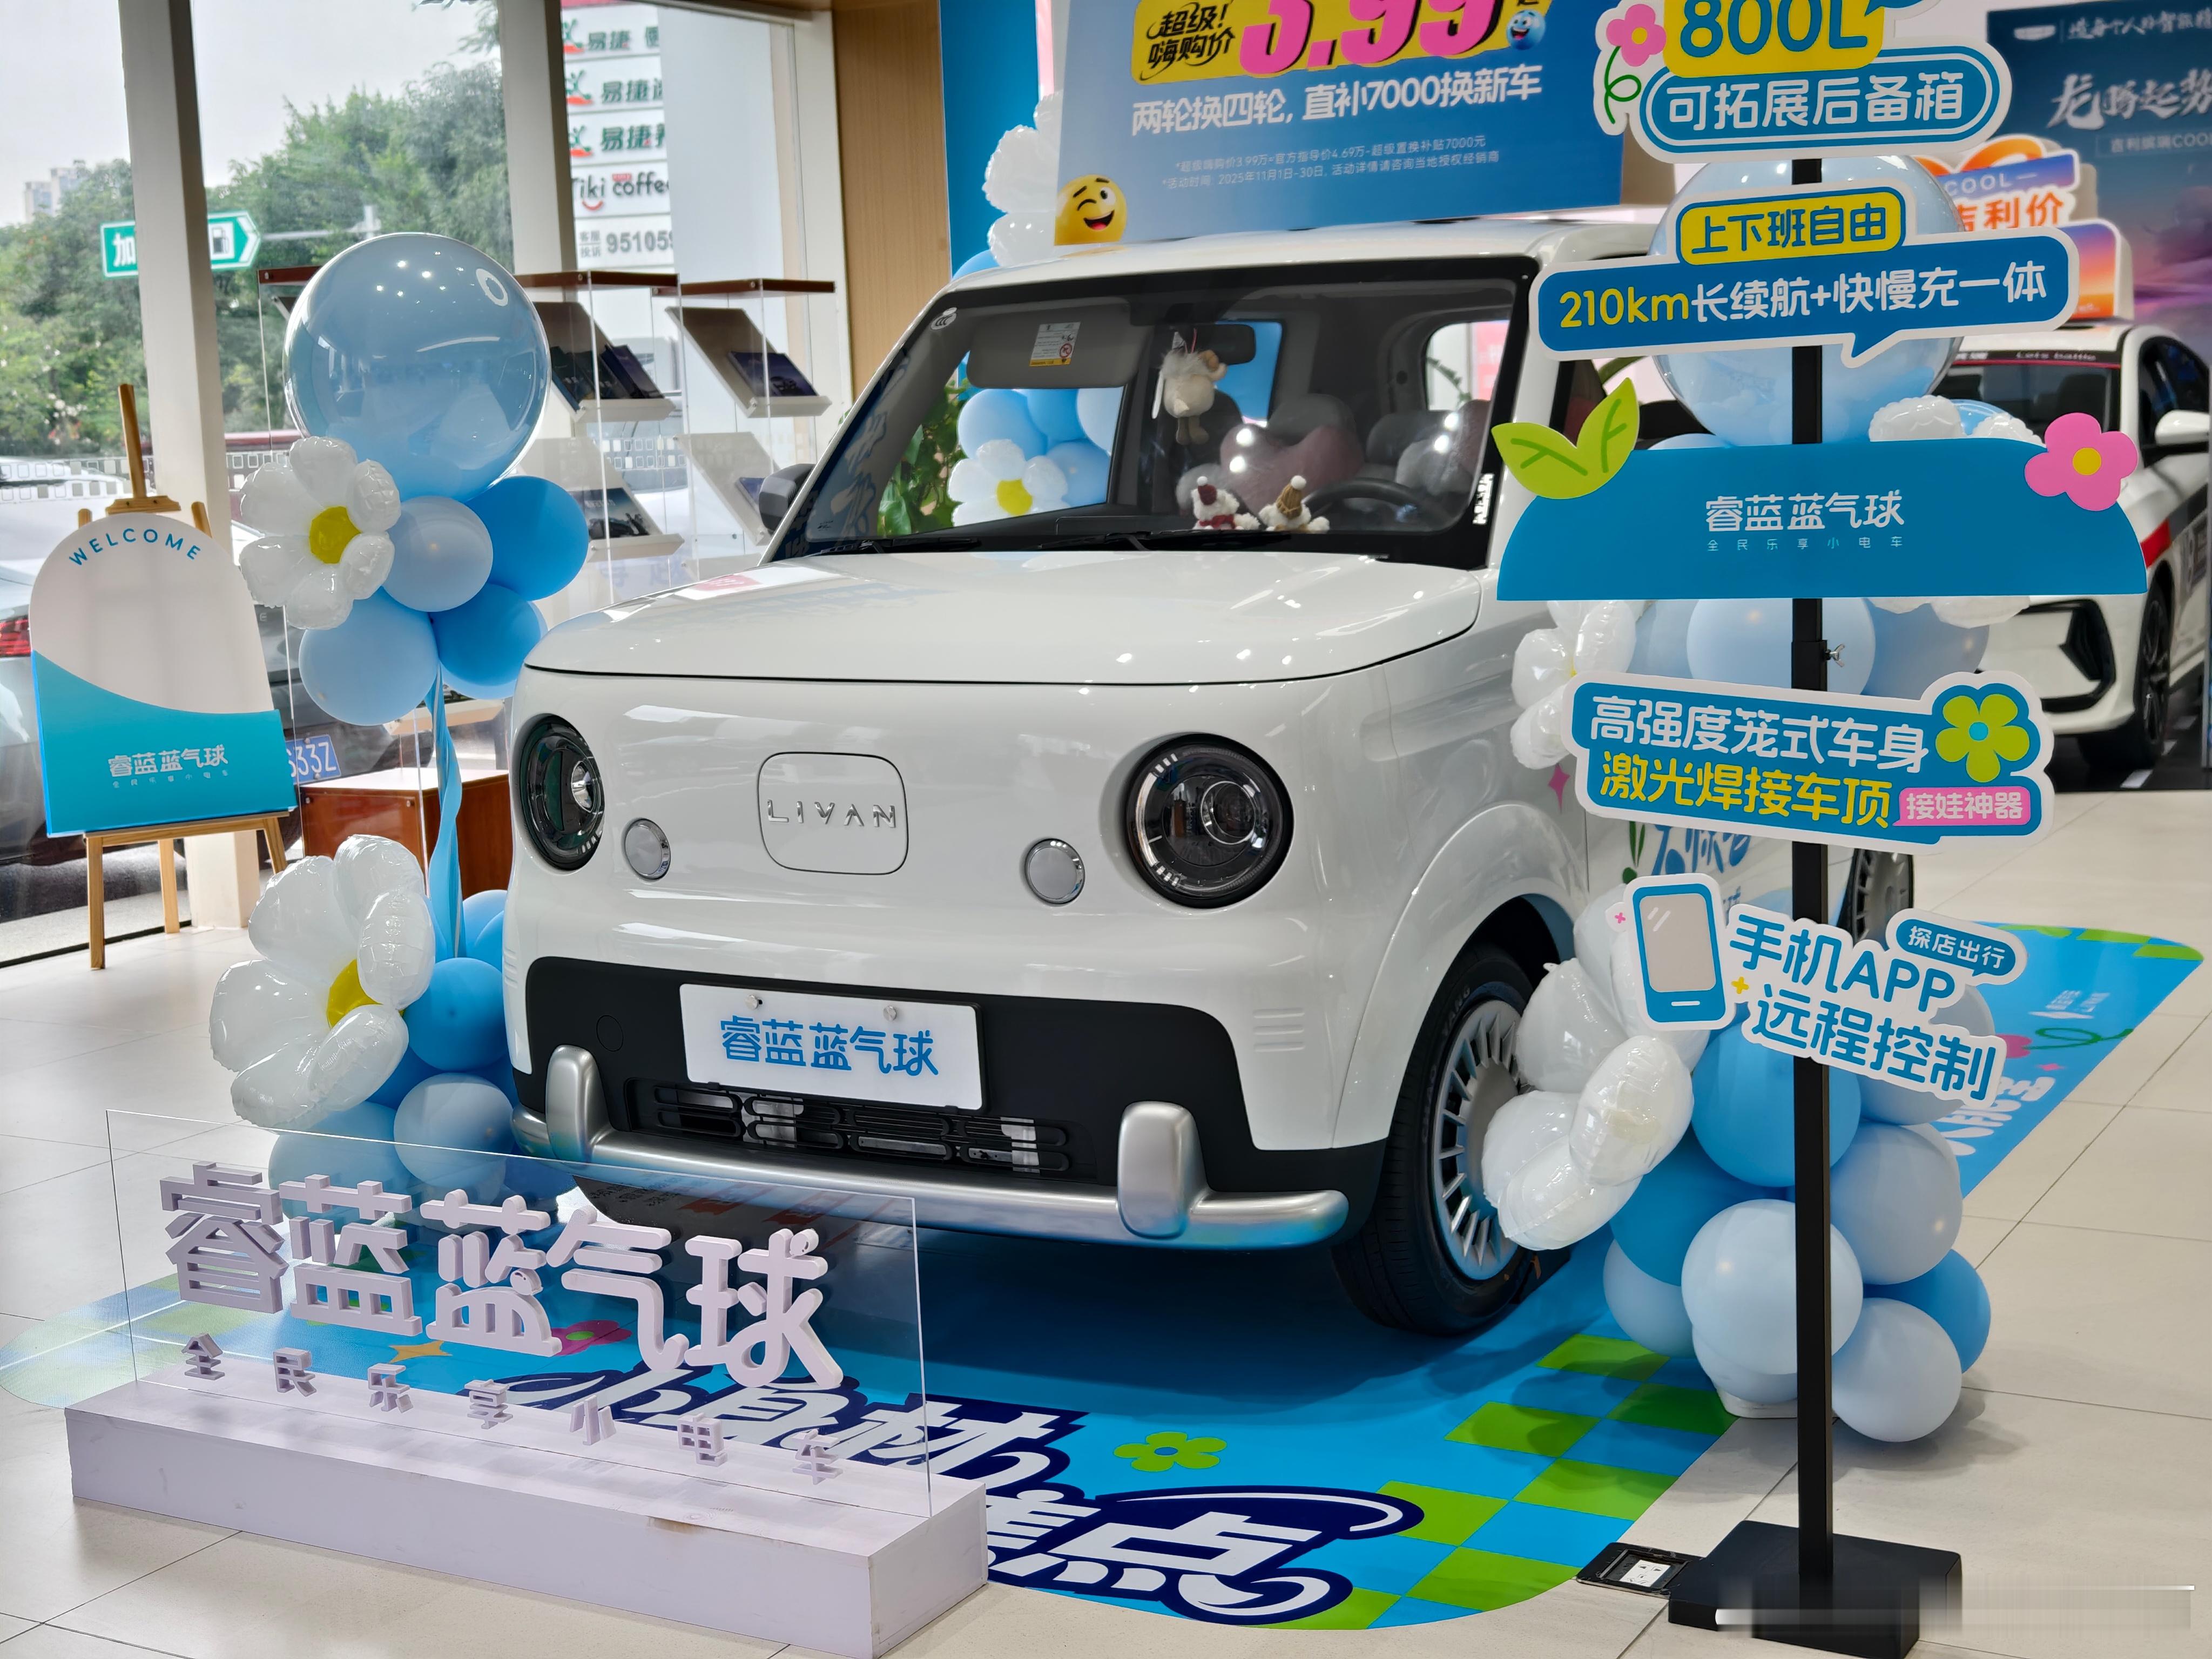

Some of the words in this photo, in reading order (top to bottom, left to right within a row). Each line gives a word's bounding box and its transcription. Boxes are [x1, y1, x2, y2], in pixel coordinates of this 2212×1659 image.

[588, 31, 630, 51] 易捷
[1680, 0, 1869, 58] 800L
[1666, 72, 1964, 132] 可拓展后备箱
[1690, 203, 1887, 255] 上下班自由
[1705, 489, 1905, 532] 睿蓝蓝气球
[69, 528, 201, 567] WELCOME
[1707, 536, 1903, 552] 全民乐享小电车
[108, 744, 229, 778] 睿蓝蓝气球
[1590, 694, 1930, 774] 高强度笼式车身
[767, 799, 897, 828] LIVAN
[1599, 751, 1894, 829] 激光焊接车顶
[1905, 792, 2025, 821] 接娃神器
[1728, 914, 1956, 1013] 手机APP
[1908, 924, 2006, 969] 探店出行
[720, 1015, 939, 1077] 睿蓝蓝气球
[1751, 984, 1998, 1102] 远程控制
[160, 1161, 845, 1389] 睿蓝蓝气球
[181, 1331, 841, 1486] 全民乐享小电车
